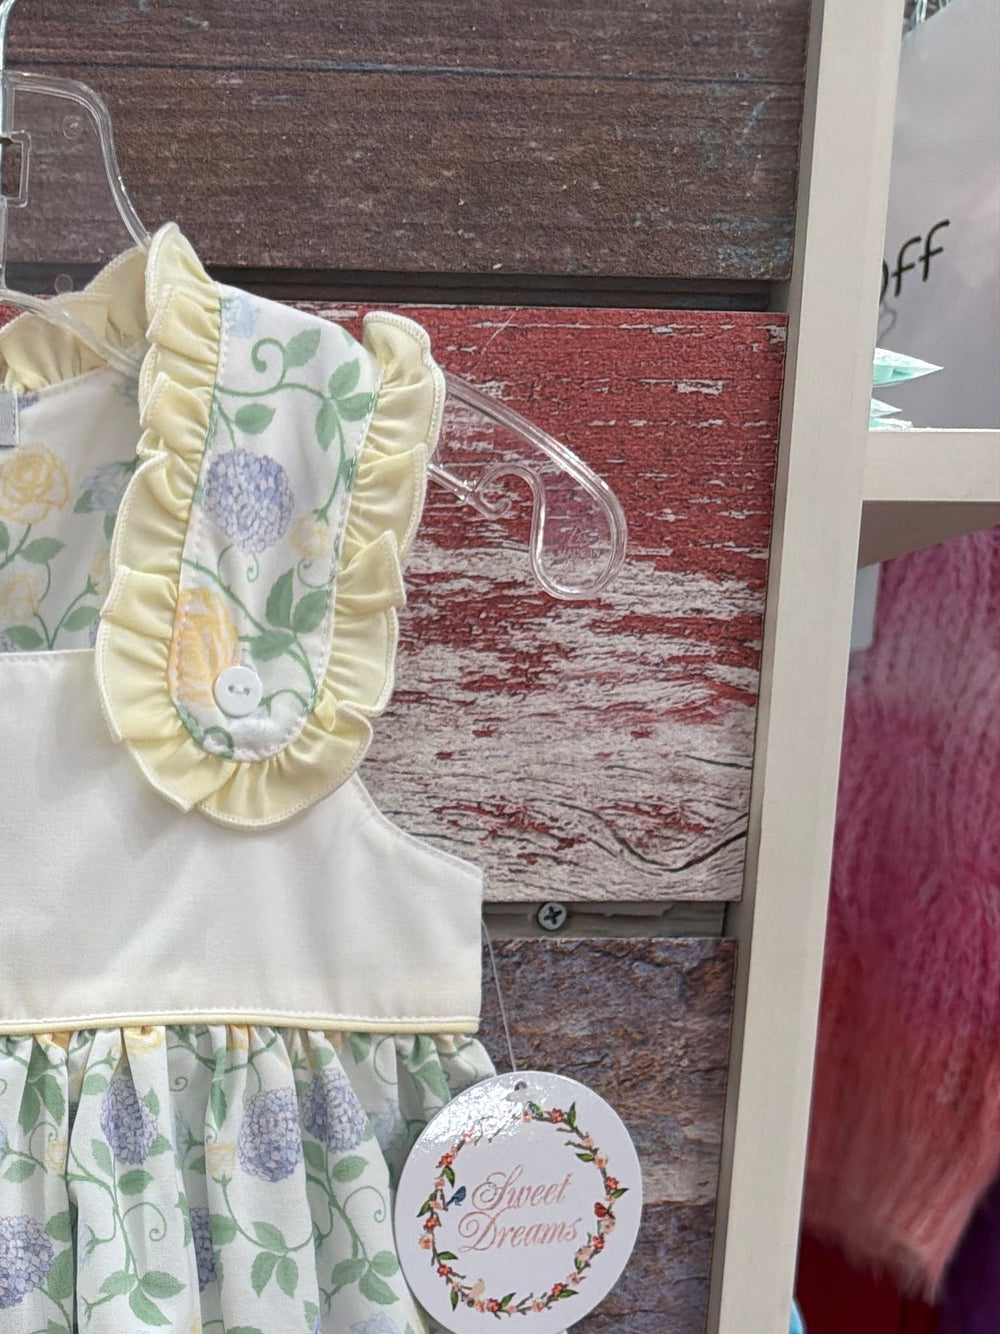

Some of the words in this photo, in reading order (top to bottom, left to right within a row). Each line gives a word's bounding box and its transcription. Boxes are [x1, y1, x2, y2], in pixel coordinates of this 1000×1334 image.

[879, 218, 951, 306] ff
[471, 1164, 572, 1211] Sweet
[457, 1210, 582, 1253] Dreams
